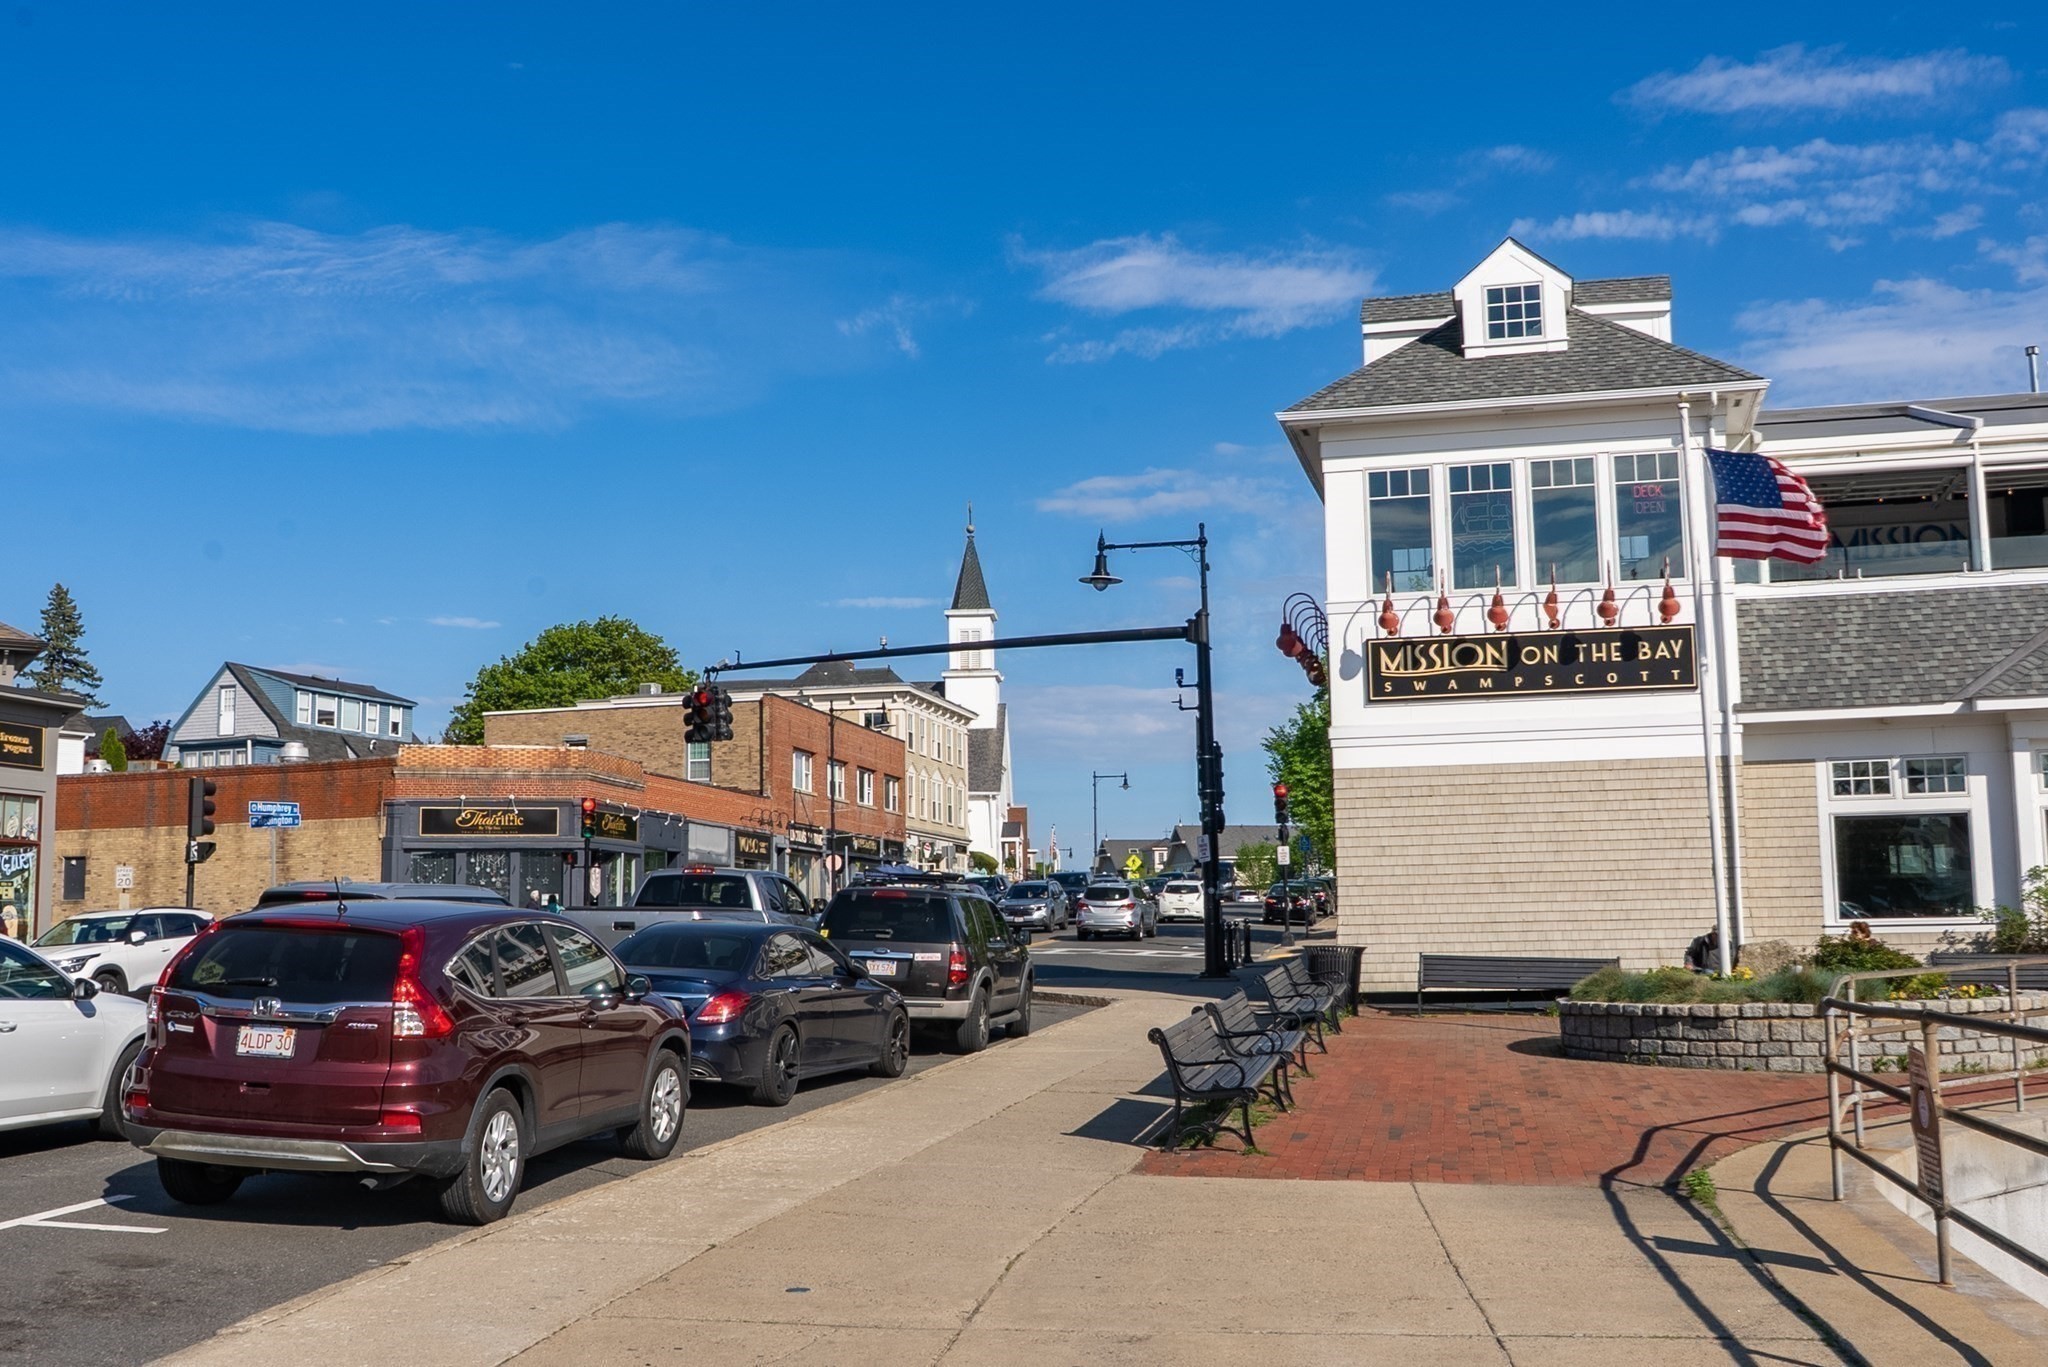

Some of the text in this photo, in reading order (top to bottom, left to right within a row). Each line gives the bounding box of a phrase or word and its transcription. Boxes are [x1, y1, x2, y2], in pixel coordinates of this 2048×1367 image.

[1633, 484, 1664, 498] DECK
[1635, 501, 1665, 514] OPEN
[1830, 523, 1971, 560] MISSION
[1380, 639, 1683, 673] MISSION ON THE BAY
[1384, 669, 1681, 692] SWAMPSCOTT
[257, 802, 292, 814] Humphrey
[117, 877, 131, 886] 20
[240, 1033, 292, 1051] 4LDP 30
